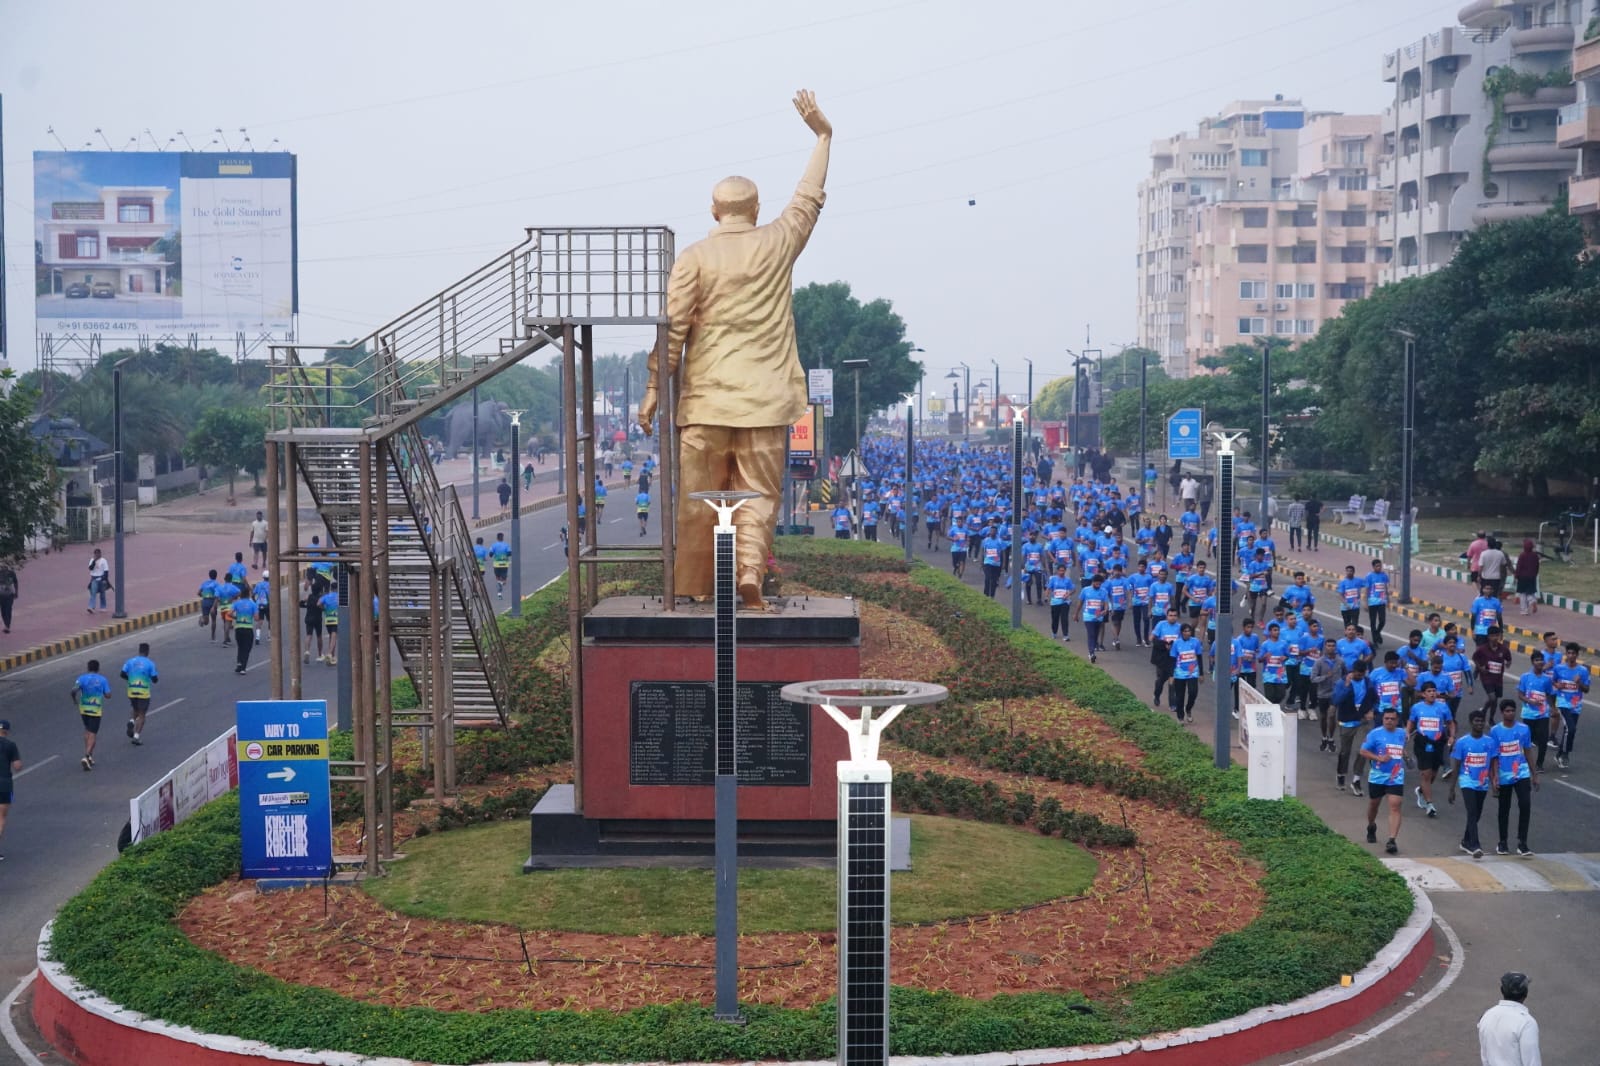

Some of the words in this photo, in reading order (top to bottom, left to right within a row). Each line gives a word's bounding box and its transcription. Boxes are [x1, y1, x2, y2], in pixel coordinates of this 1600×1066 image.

[193, 208, 210, 217] The
[213, 207, 236, 217] Gold
[239, 207, 281, 217] Standard
[264, 724, 285, 738] WAY
[287, 723, 300, 738] TO
[267, 744, 283, 756] CAR
[285, 743, 320, 756] PARKING
